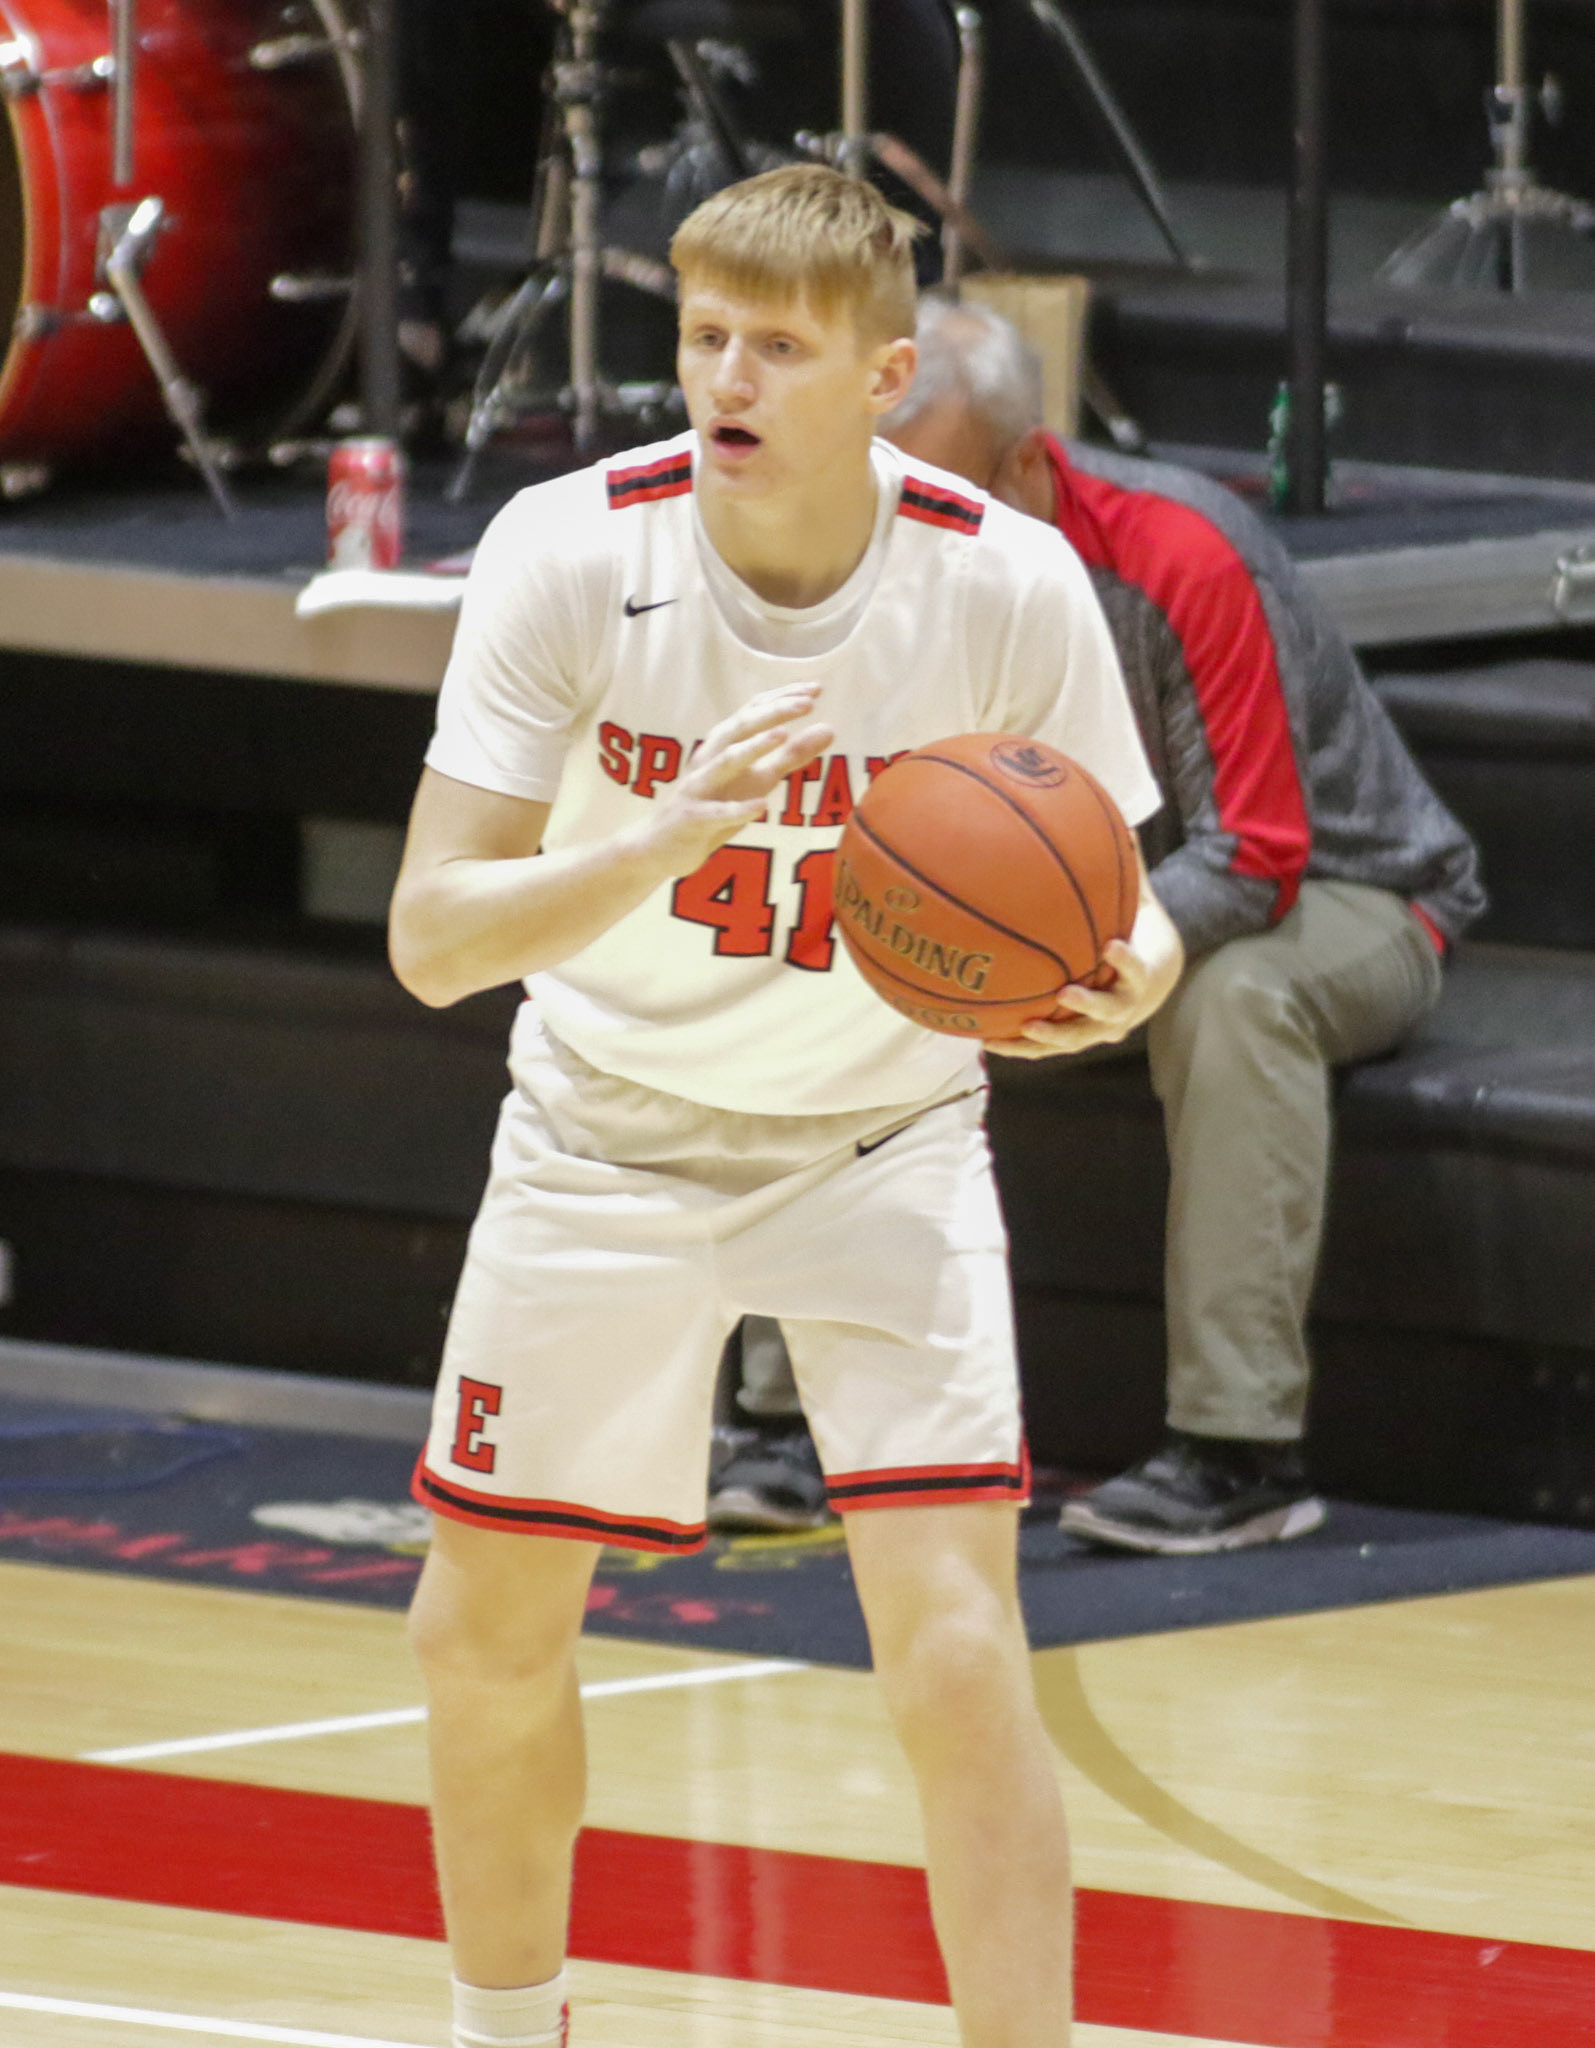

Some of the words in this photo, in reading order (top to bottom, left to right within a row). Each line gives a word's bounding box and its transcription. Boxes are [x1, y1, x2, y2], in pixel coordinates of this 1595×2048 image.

[598, 720, 909, 827] SPTA
[671, 844, 838, 972] 41
[450, 1374, 503, 1475] E
